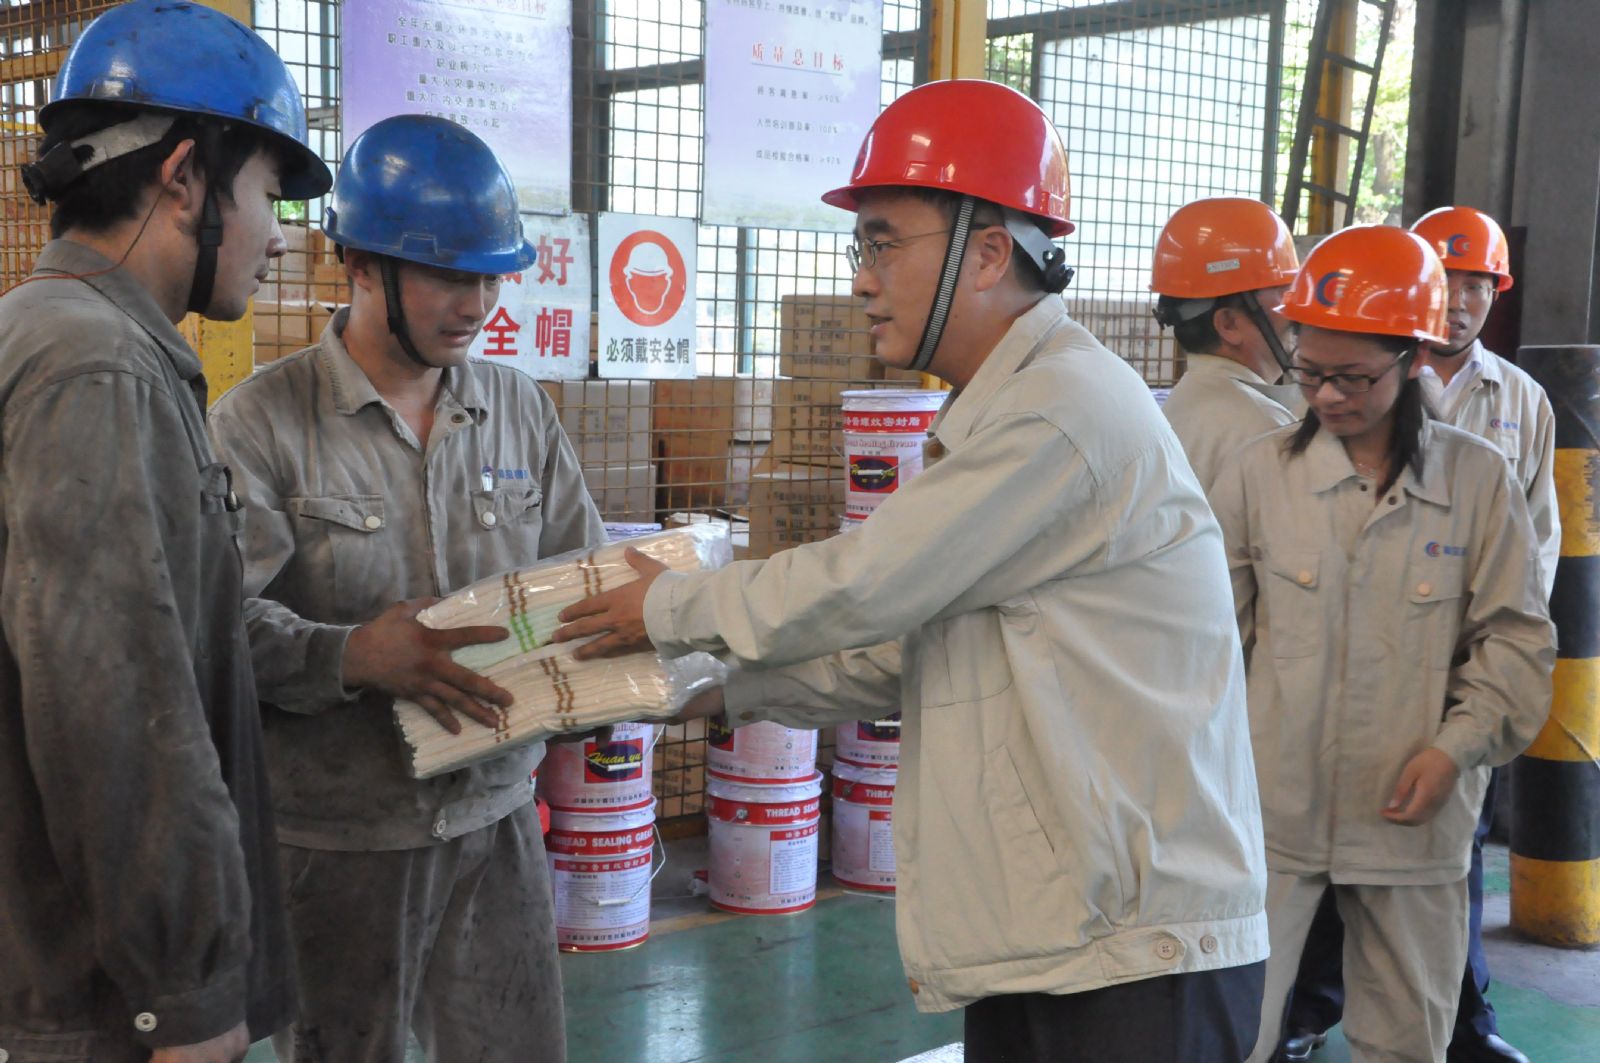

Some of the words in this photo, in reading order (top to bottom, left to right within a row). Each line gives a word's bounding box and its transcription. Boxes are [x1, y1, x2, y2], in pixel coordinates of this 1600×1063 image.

[752, 43, 844, 71] 质量总目标
[606, 338, 690, 364] 必须戴安全帽
[588, 752, 625, 764] Huan
[765, 806, 800, 818] THREAD
[552, 834, 587, 847] THREAD
[592, 834, 632, 847] SEALING
